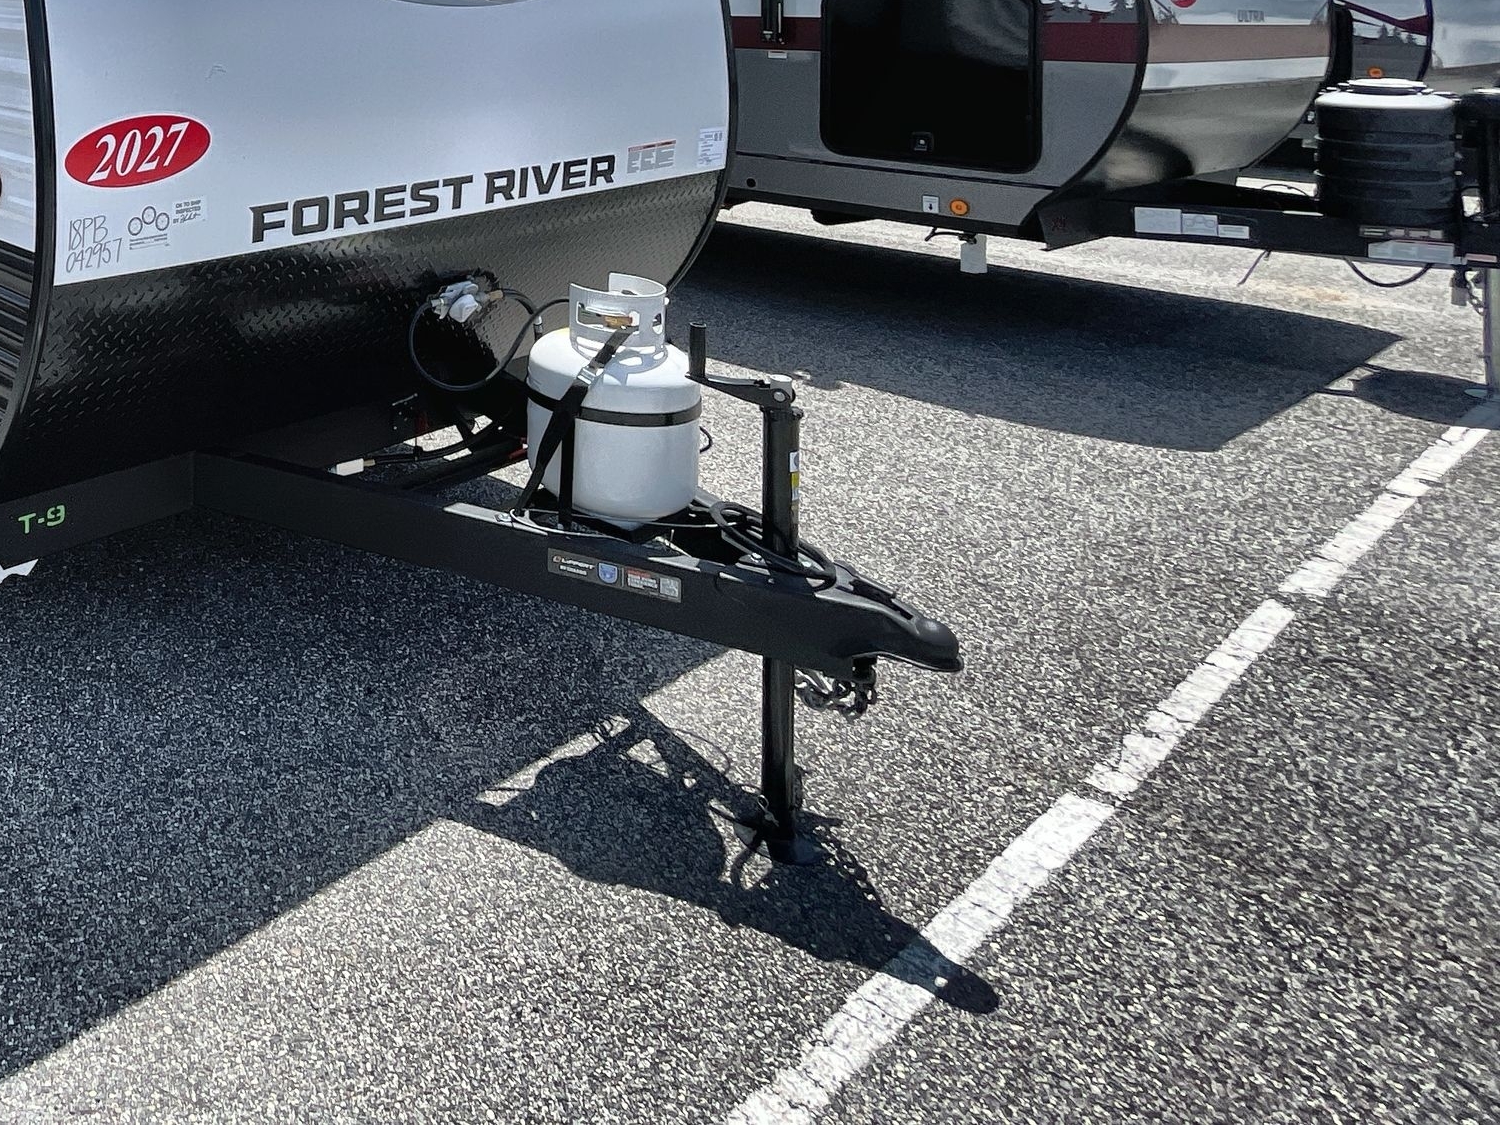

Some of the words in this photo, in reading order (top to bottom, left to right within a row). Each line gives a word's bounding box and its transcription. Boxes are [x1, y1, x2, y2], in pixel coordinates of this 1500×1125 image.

[87, 121, 190, 183] 2027
[248, 174, 474, 244] FOREST
[483, 154, 616, 205] RIVER
[18, 505, 65, 534] T-9
